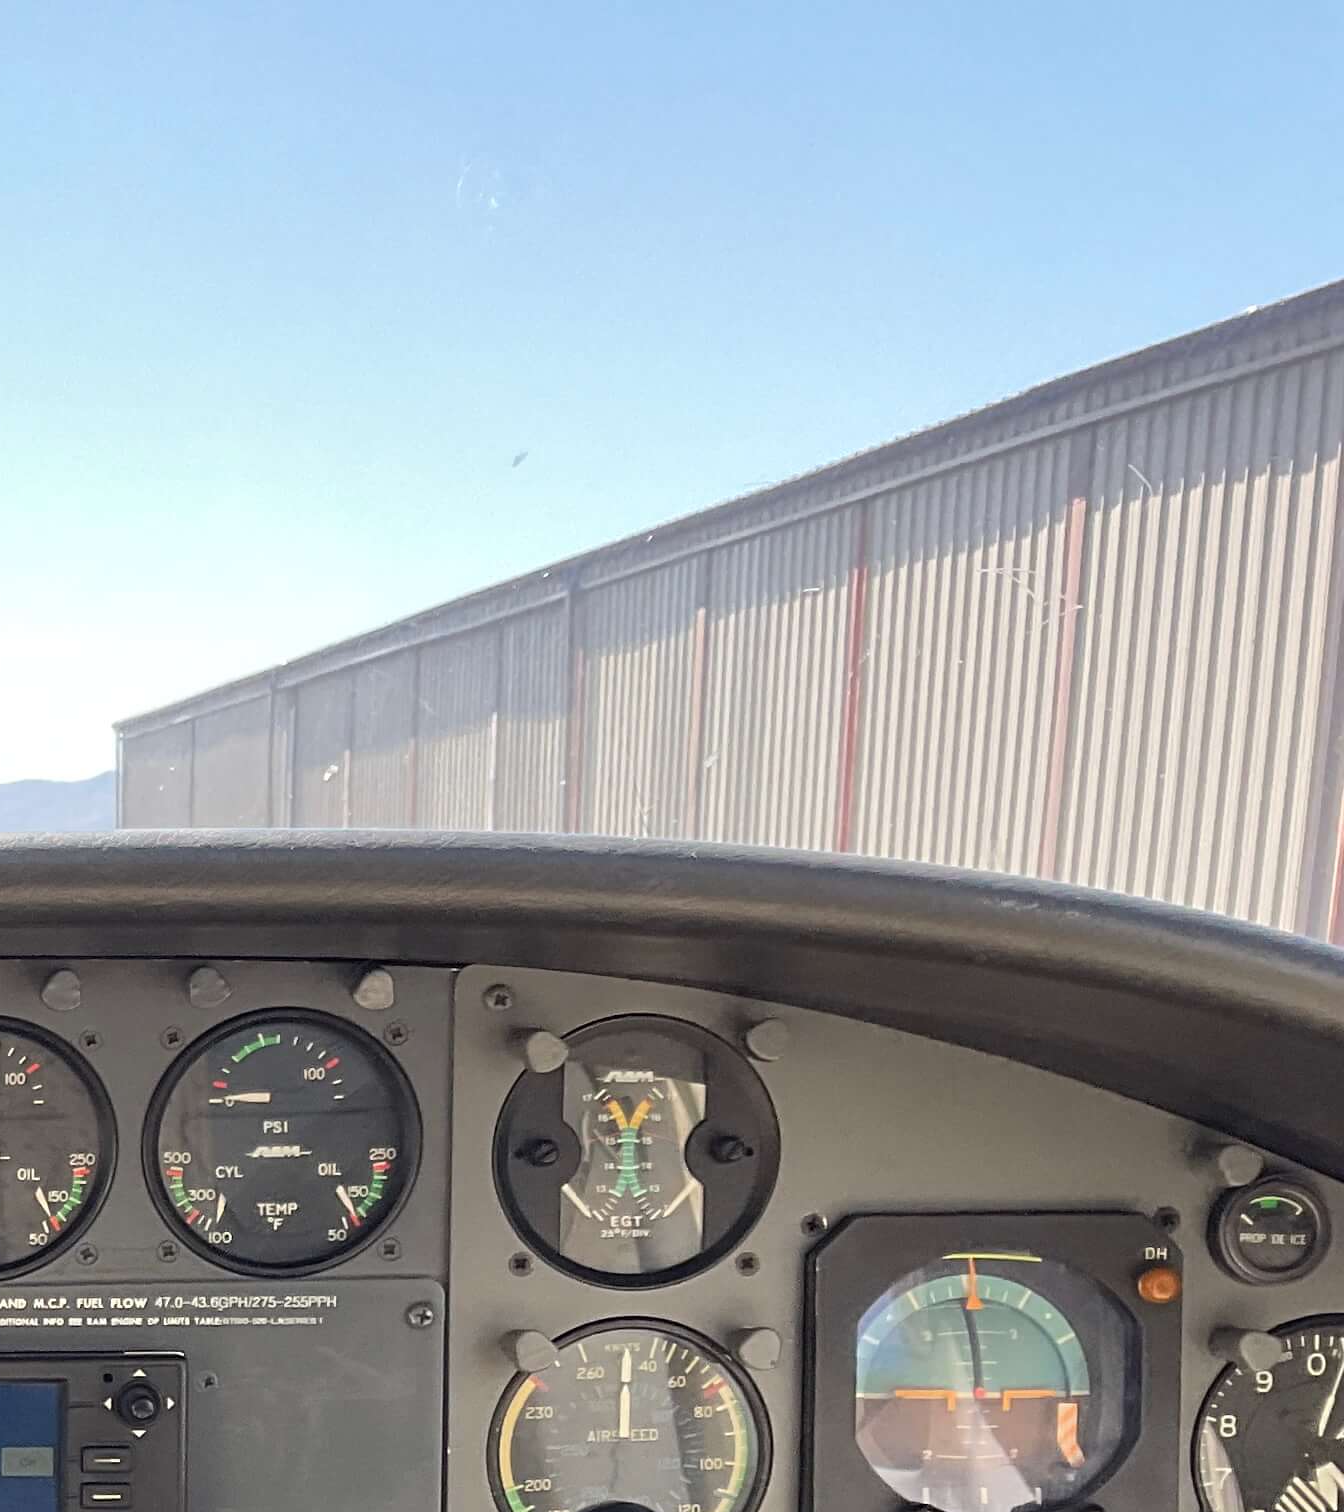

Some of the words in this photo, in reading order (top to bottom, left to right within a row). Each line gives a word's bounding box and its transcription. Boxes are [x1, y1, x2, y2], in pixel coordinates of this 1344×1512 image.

[17, 1169, 40, 1181] OIL
[1145, 1247, 1167, 1260] DH
[0, 1299, 26, 1309] AND
[34, 1299, 69, 1309] M.C.P.
[76, 1298, 104, 1308] FUEL
[111, 1298, 147, 1308] FLOW
[699, 1458, 722, 1469] 100
